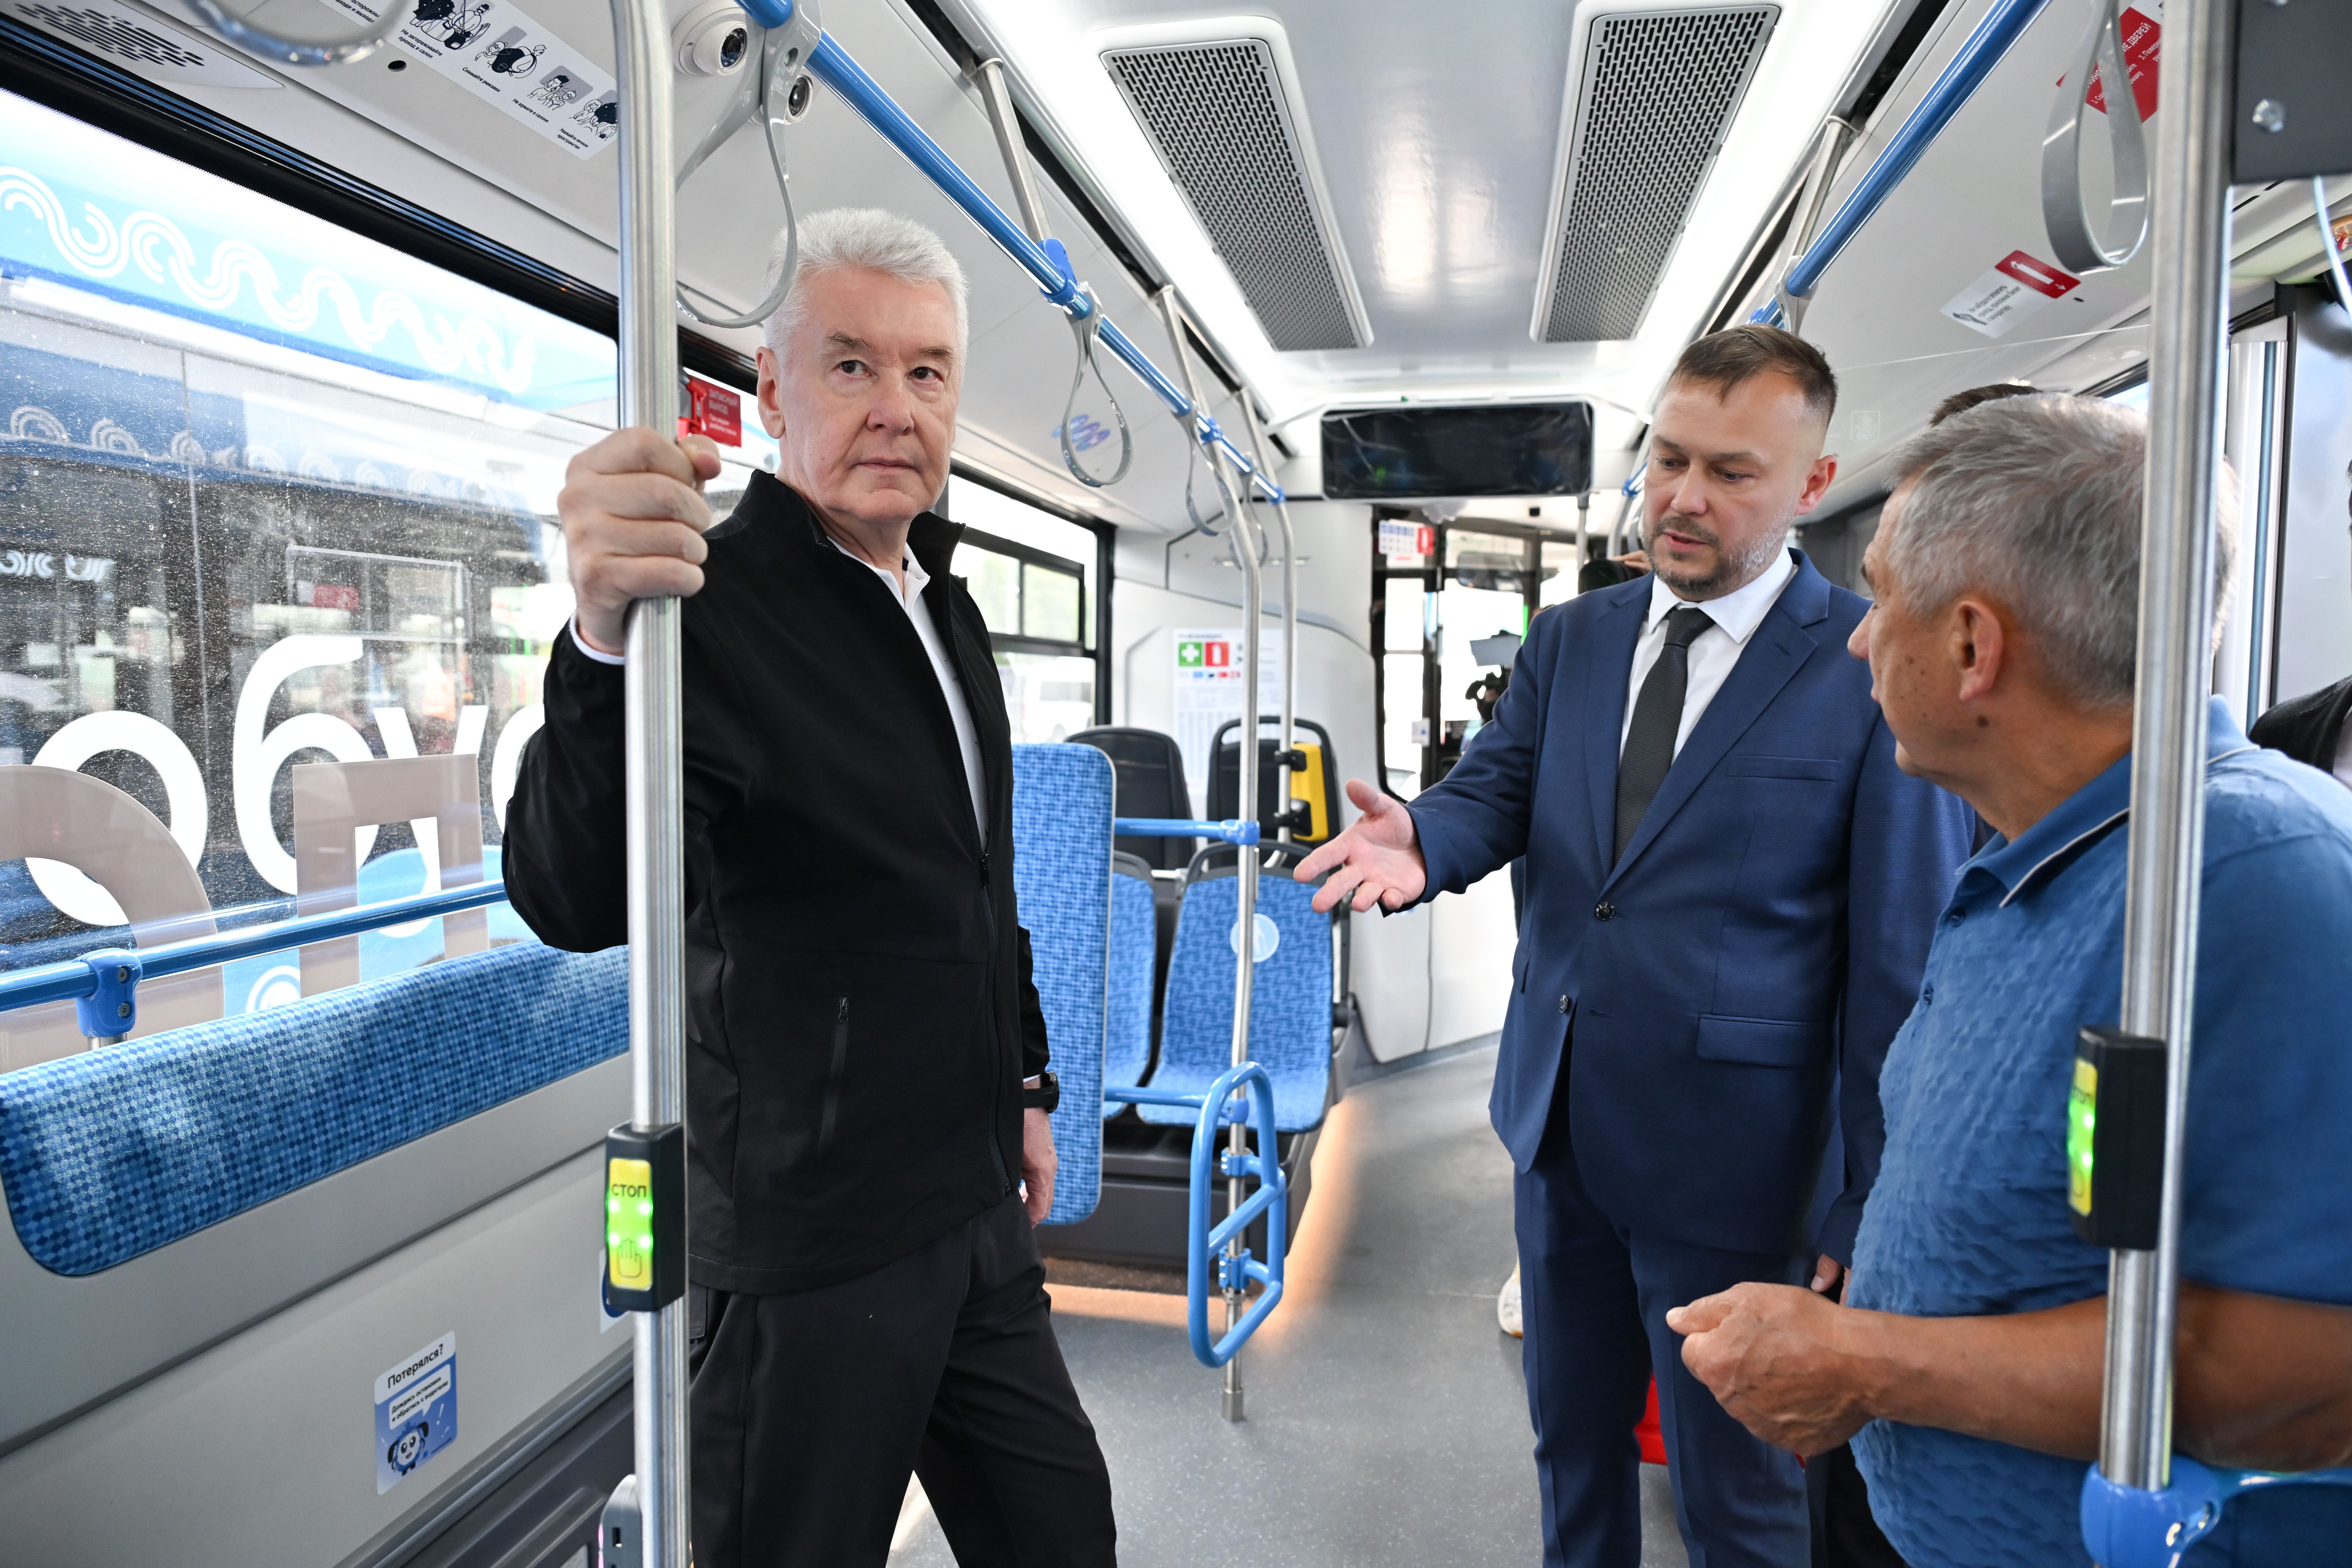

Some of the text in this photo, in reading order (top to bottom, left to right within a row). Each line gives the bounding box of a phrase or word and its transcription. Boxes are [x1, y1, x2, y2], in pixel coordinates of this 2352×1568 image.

[356, 10, 375, 23] выходе
[2127, 22, 2151, 46] ДВЕРЕЙ
[398, 36, 416, 49] проход
[419, 49, 433, 58] салон
[408, 34, 443, 56] загораживайте
[2142, 38, 2162, 56] Поверни
[2153, 52, 2161, 62] руч
[2126, 63, 2137, 73] ойте
[2129, 71, 2144, 84] рышку
[462, 67, 501, 92] Снимайте рюкзаки
[518, 103, 533, 113] шумите
[535, 113, 549, 123] салоне
[557, 134, 580, 149] пространство
[559, 128, 588, 148] Уважайте личное
[612, 1184, 646, 1198] СТОП
[388, 1343, 443, 1389] Потерялся?
